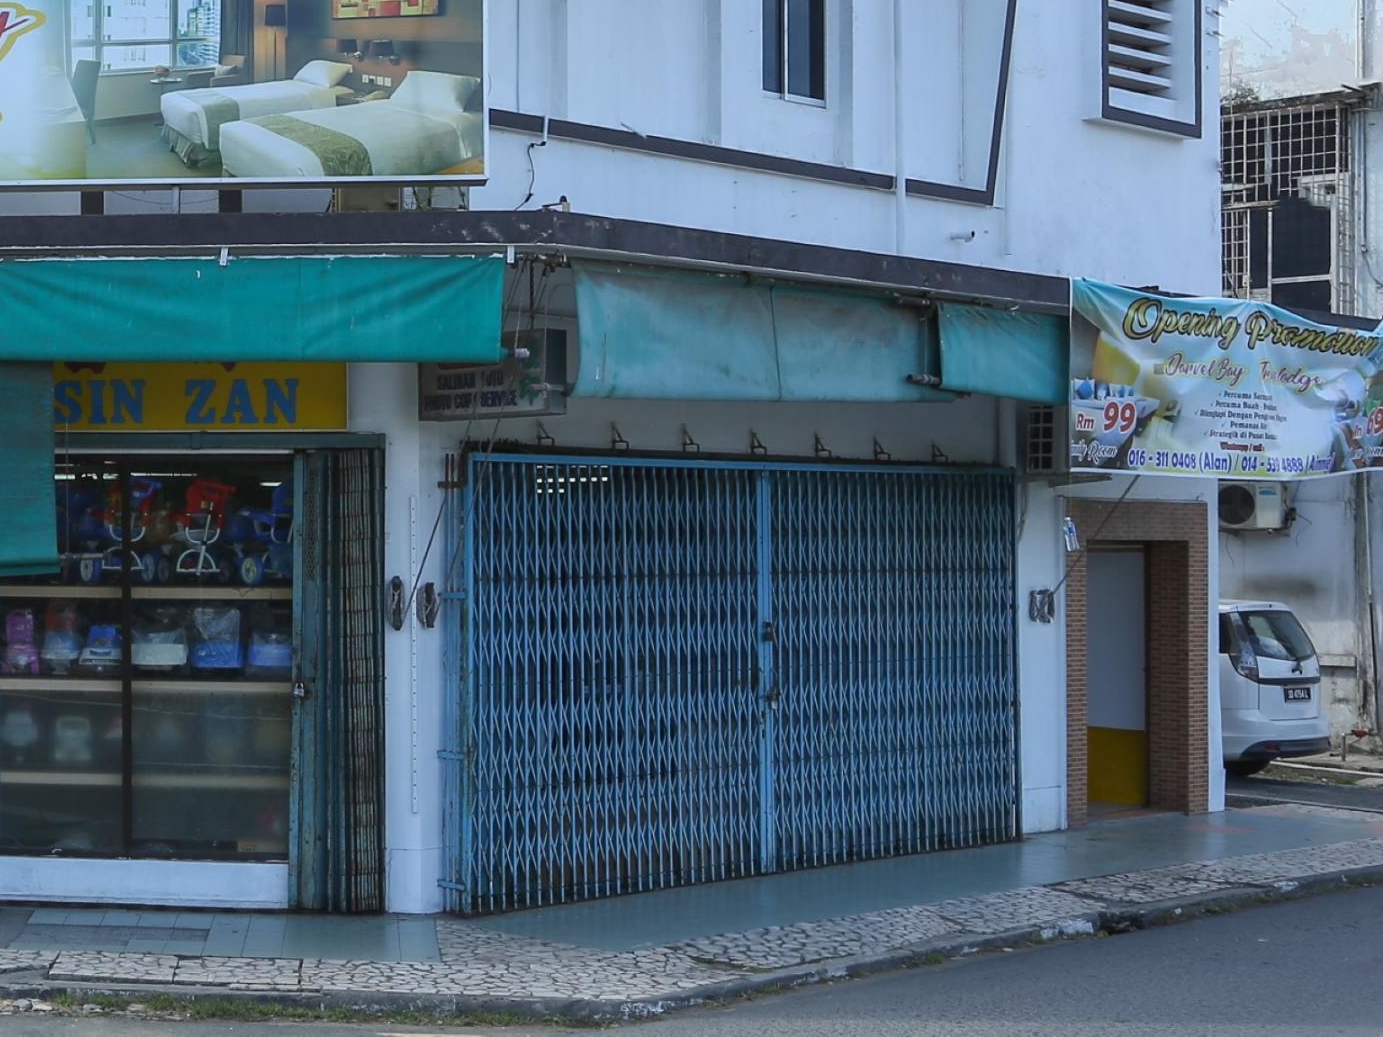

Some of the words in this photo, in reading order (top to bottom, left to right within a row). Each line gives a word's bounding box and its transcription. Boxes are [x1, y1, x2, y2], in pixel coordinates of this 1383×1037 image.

[1123, 298, 1240, 350] Opening
[1164, 353, 1215, 377] Darvel
[1216, 357, 1243, 387] Bay
[54, 379, 146, 424] SIN
[185, 379, 299, 424] ZAN
[1076, 413, 1094, 431] Rm
[1104, 402, 1136, 433] 99
[1128, 450, 1145, 467] 016
[1156, 451, 1169, 467] 311
[1172, 452, 1196, 469] 0408
[1199, 452, 1232, 475] (Alan)
[1241, 457, 1257, 472] 014
